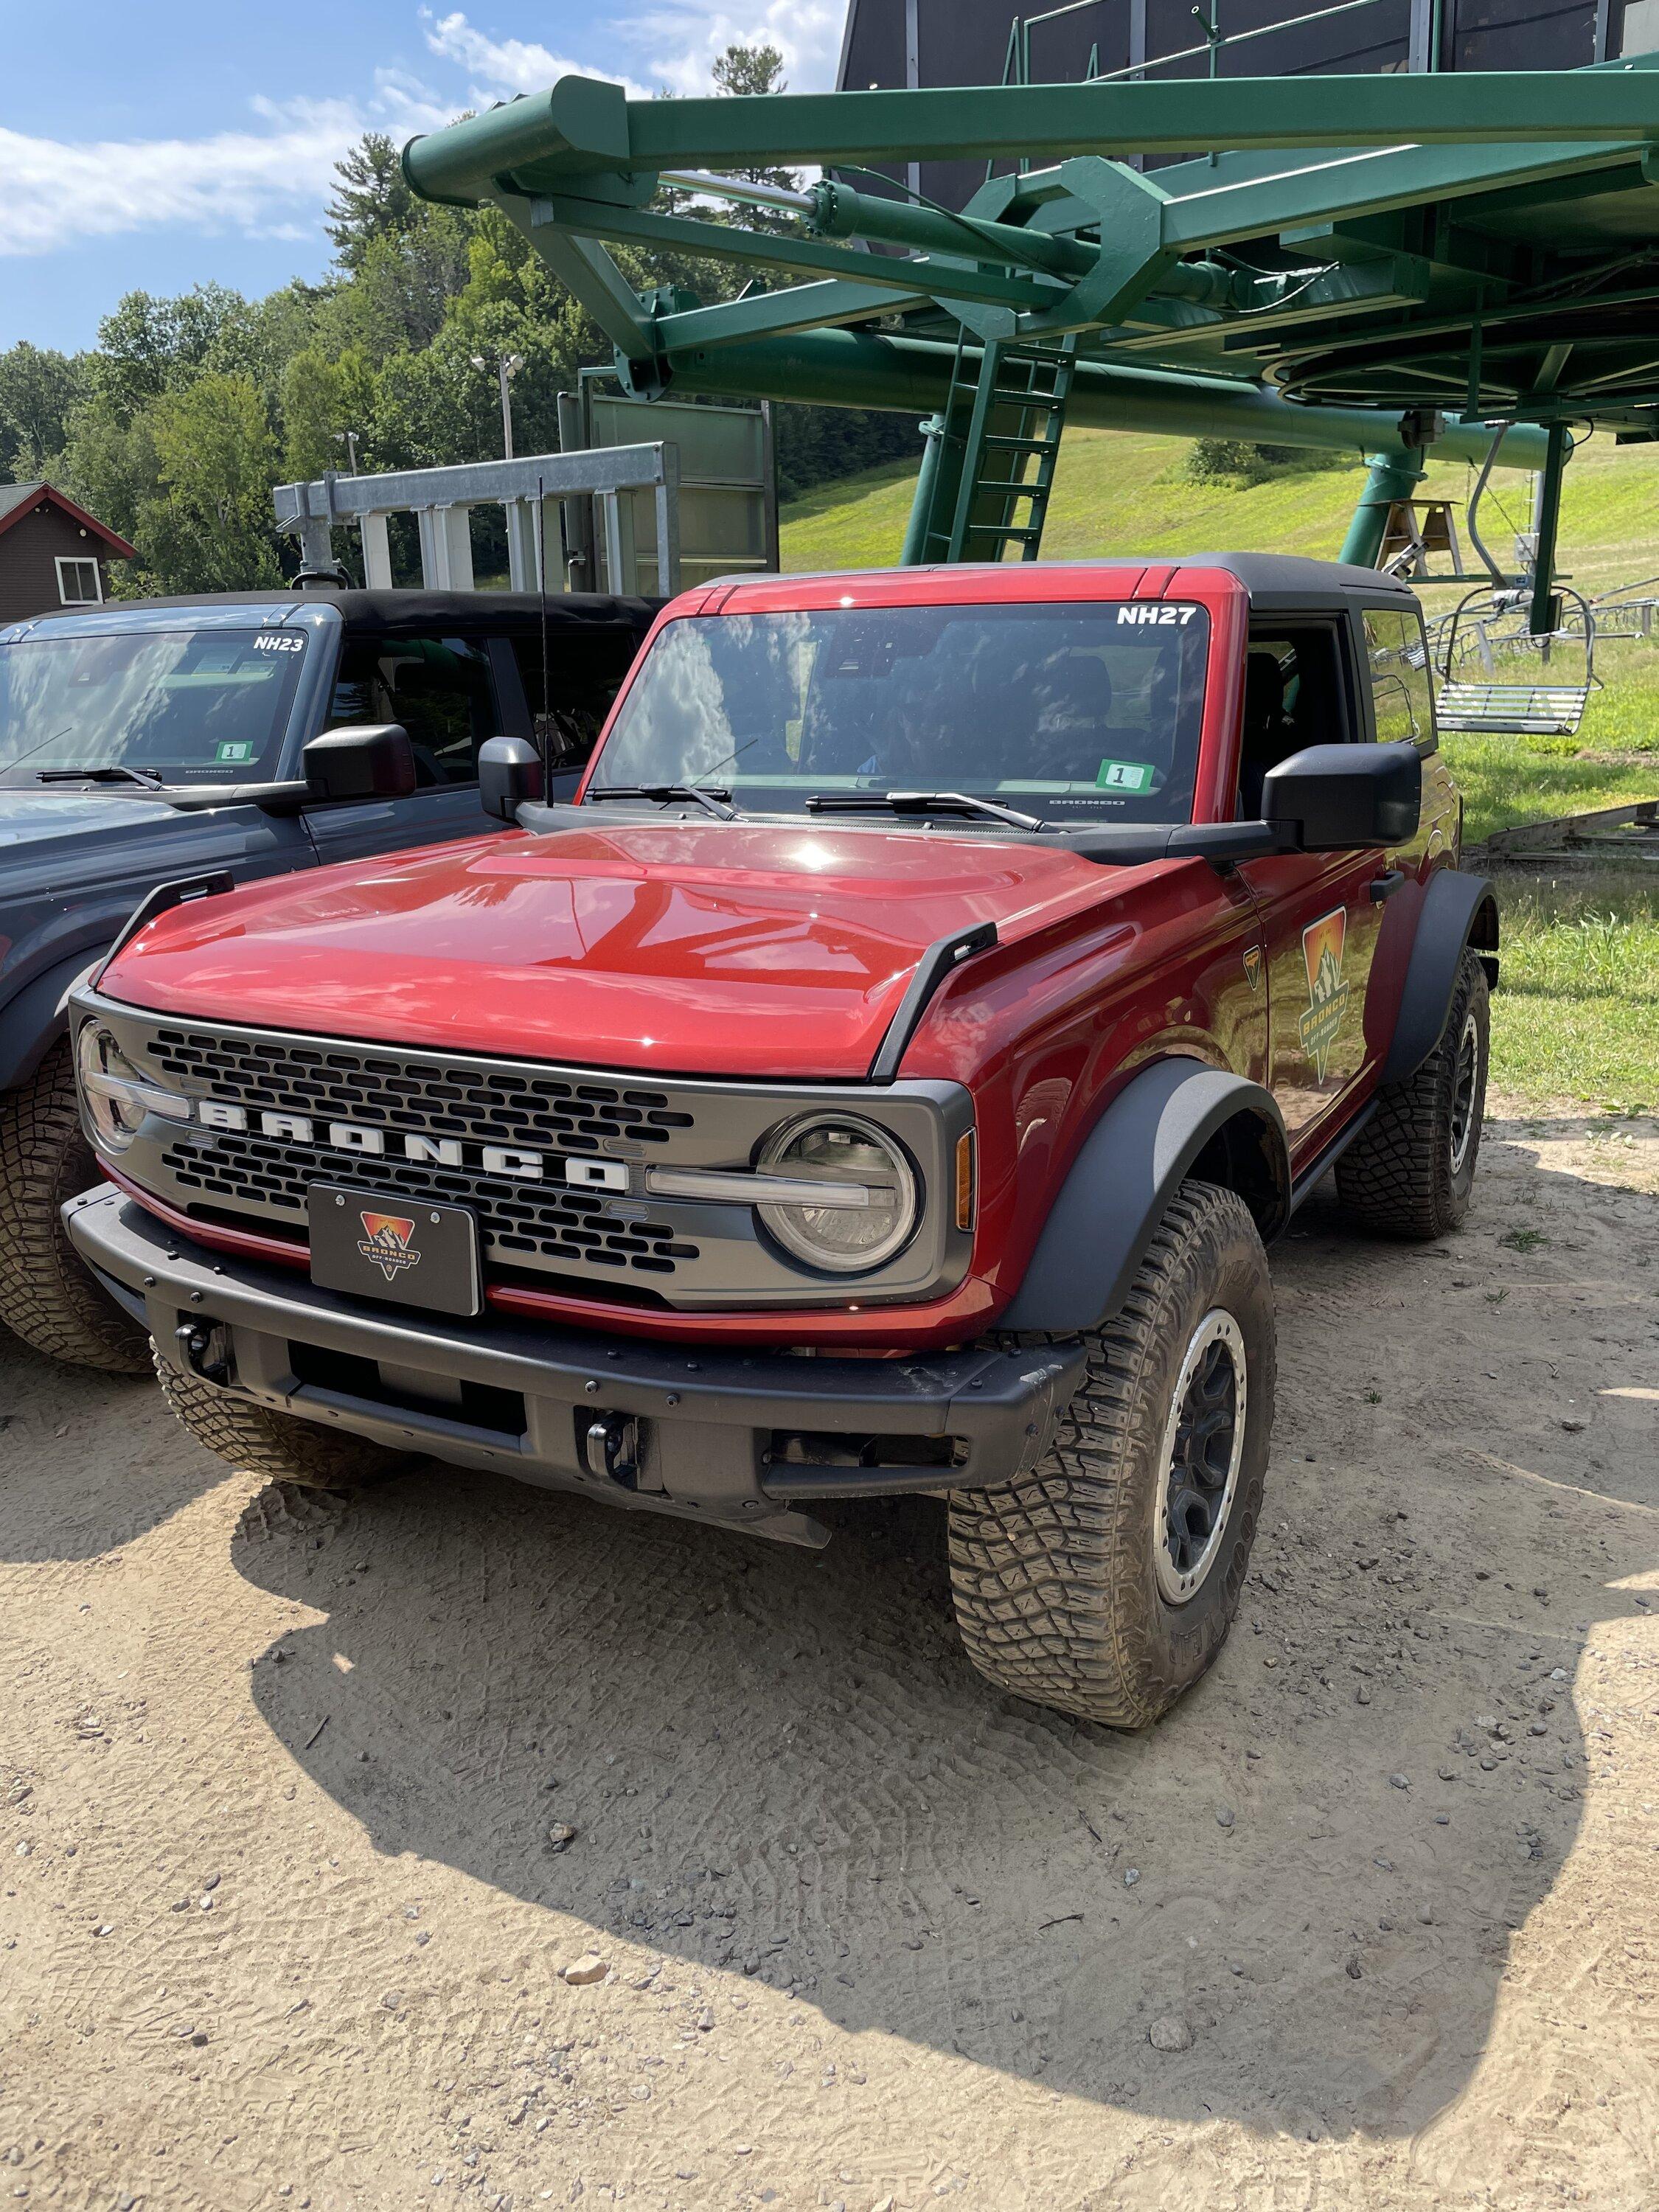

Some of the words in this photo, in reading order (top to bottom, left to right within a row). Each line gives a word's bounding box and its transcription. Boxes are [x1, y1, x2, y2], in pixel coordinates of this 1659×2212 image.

[1117, 607, 1197, 625] NH27
[253, 636, 304, 652] NH23
[226, 745, 234, 757] 1
[1113, 768, 1124, 784] 1
[1303, 993, 1346, 1036] BRONCO
[198, 1100, 630, 1191] BRONCO
[362, 1245, 416, 1261] BRONCO
